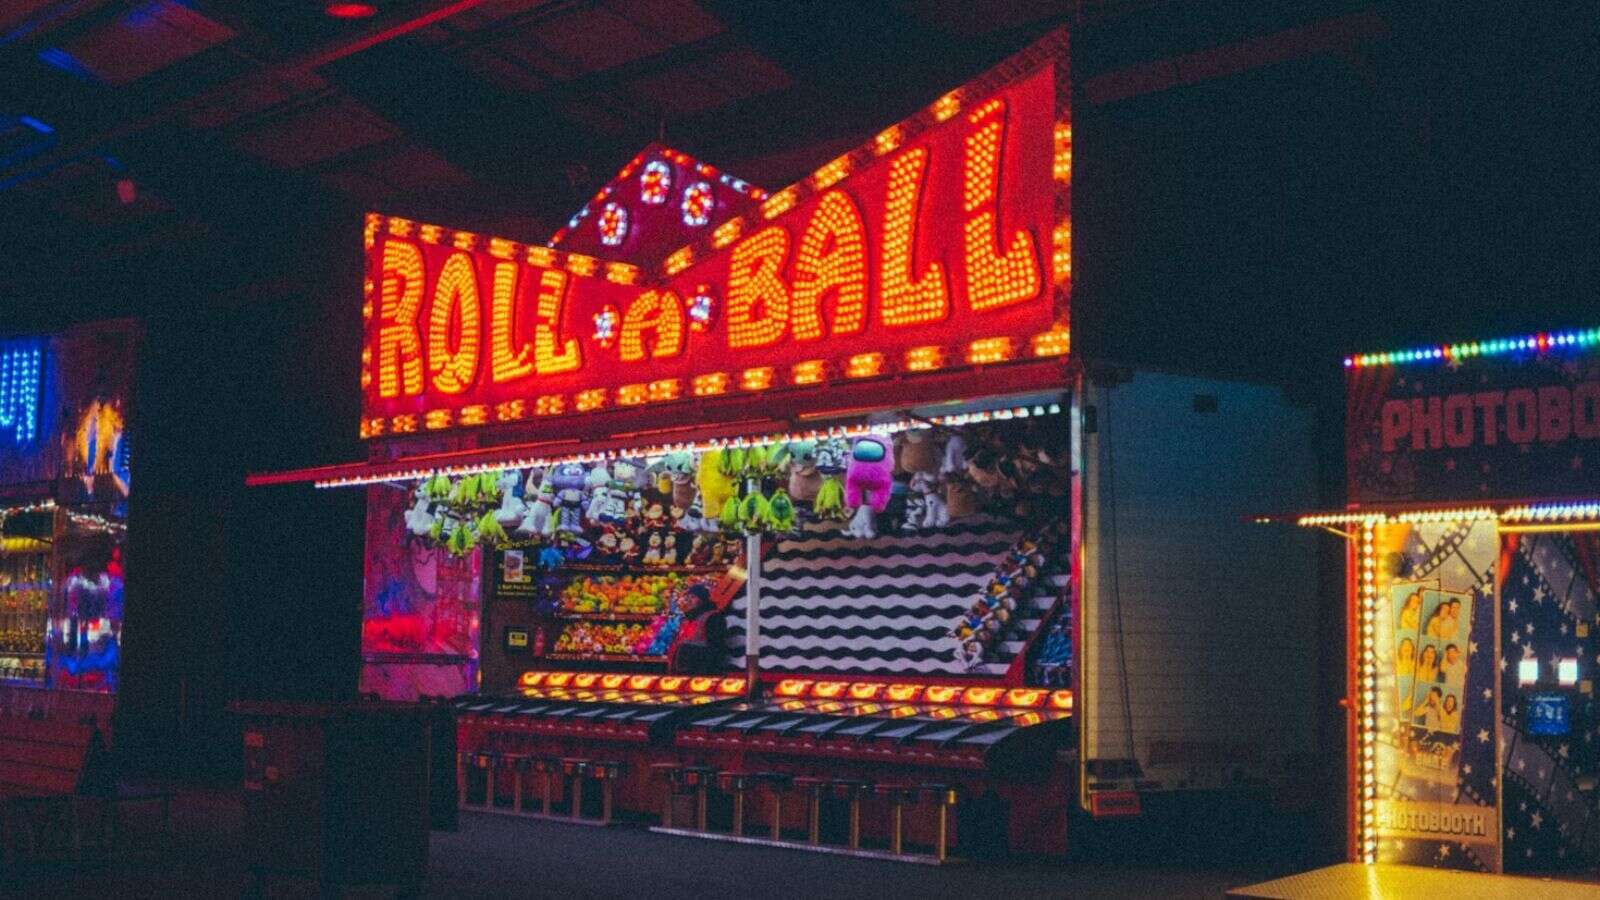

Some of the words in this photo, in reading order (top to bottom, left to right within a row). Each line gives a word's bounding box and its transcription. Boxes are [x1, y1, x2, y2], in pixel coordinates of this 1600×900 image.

[378, 239, 580, 398] ROLL
[619, 289, 683, 361] A
[726, 99, 1042, 349] BALL
